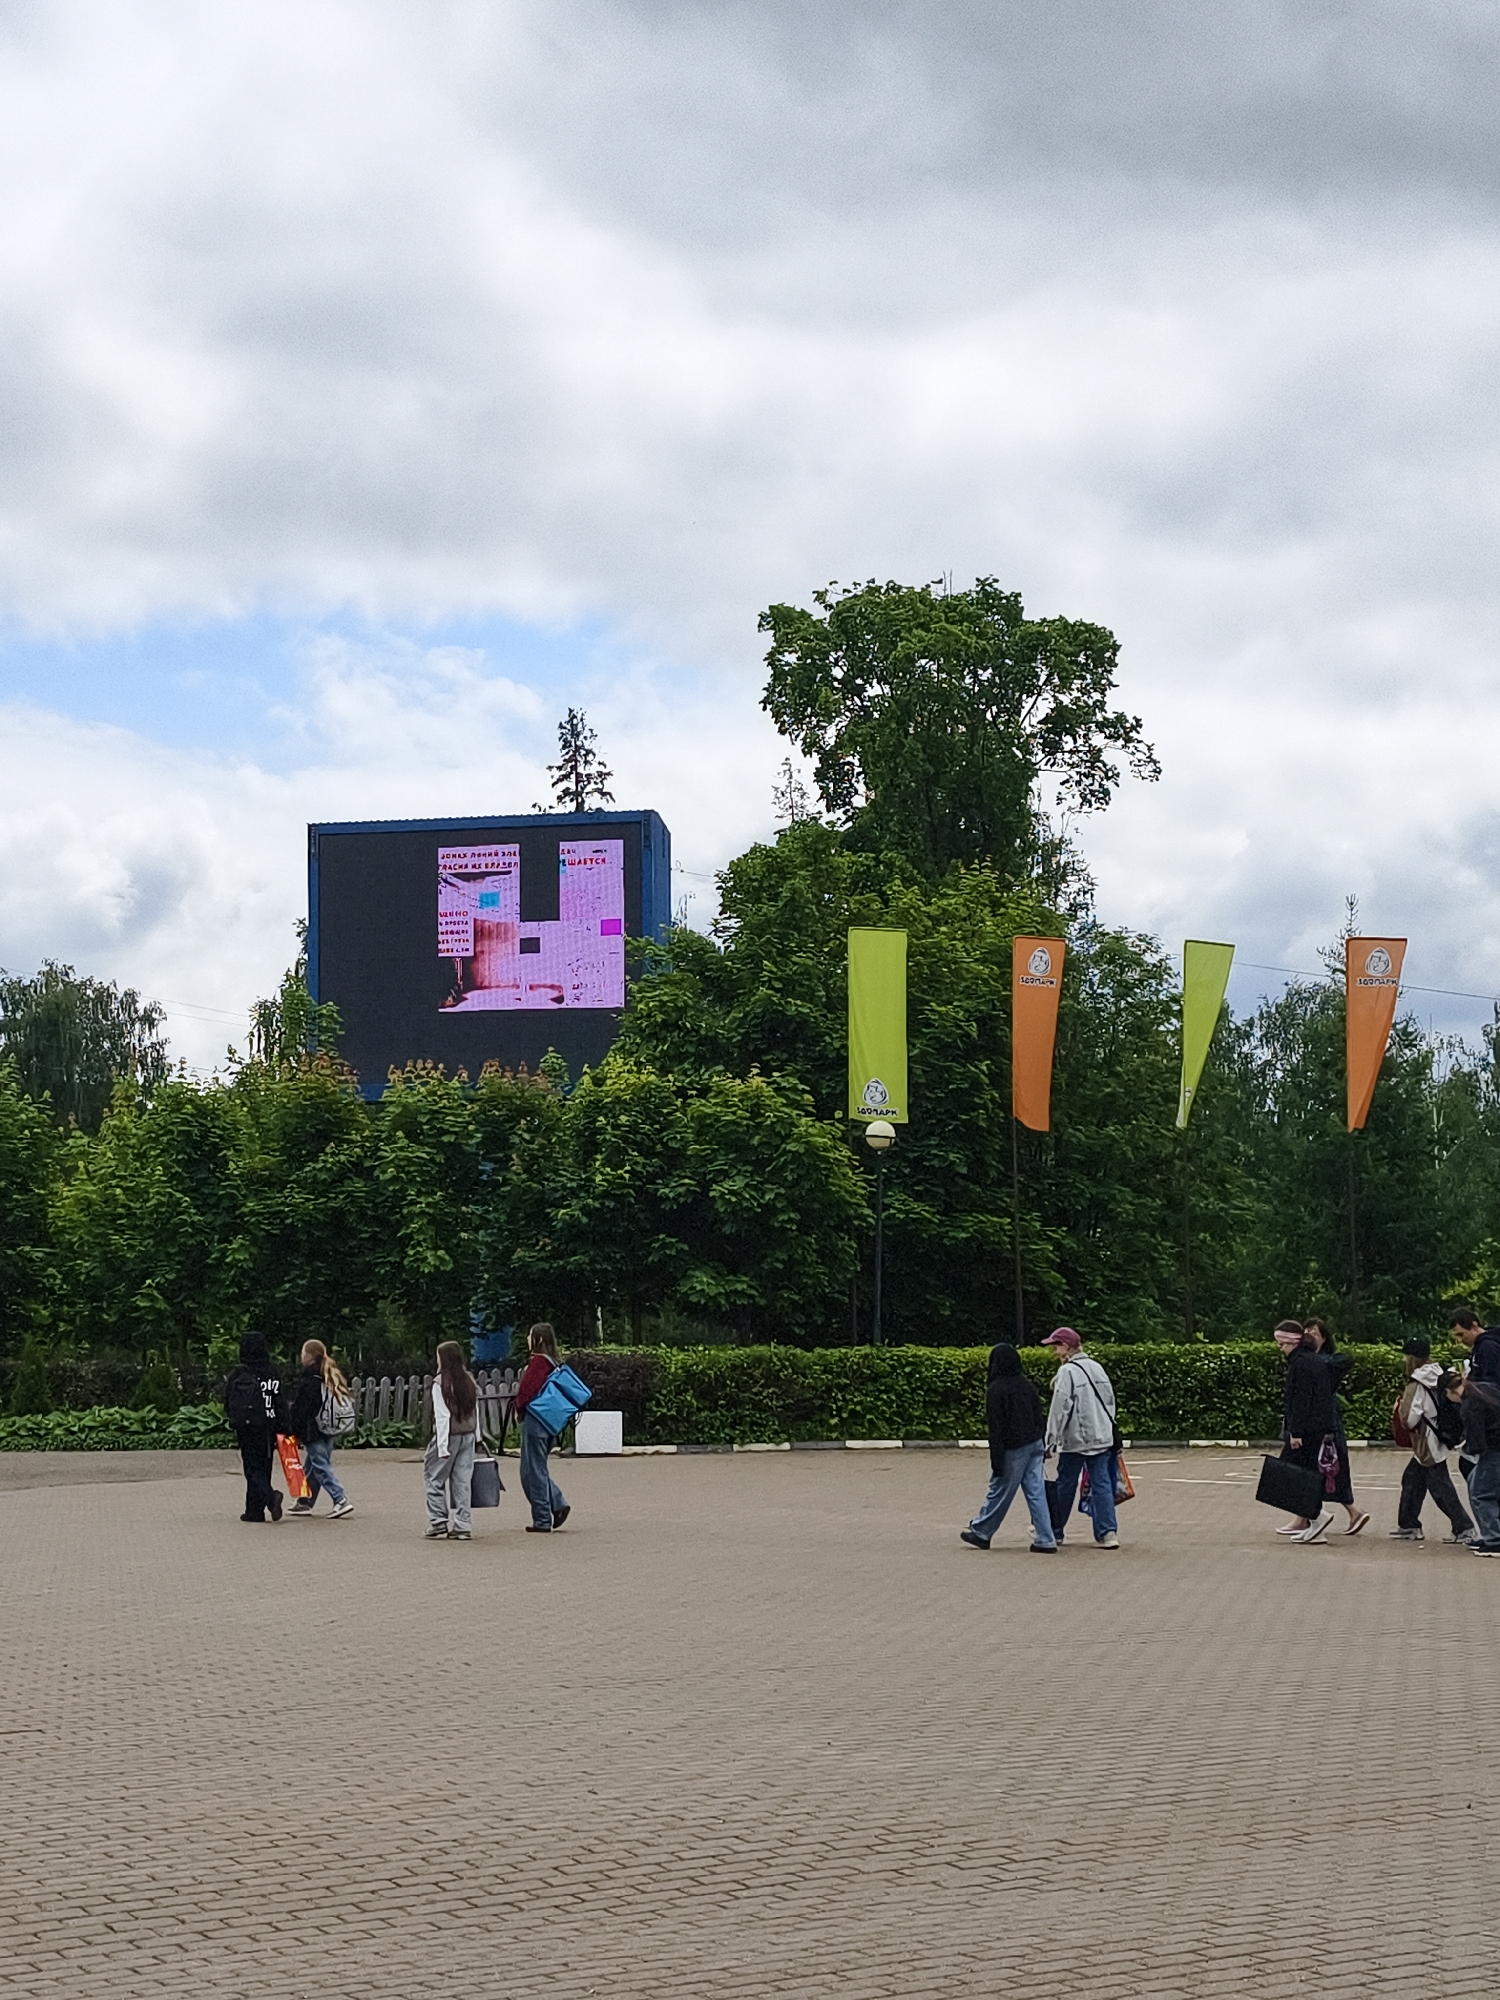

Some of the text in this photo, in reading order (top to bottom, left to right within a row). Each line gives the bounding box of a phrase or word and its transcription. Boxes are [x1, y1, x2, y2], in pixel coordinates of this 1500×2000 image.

[1020, 976, 1055, 986] ЗООПАРК
[1357, 977, 1399, 987] ЗООПАРК
[856, 1106, 898, 1116] ЗООПАРК
